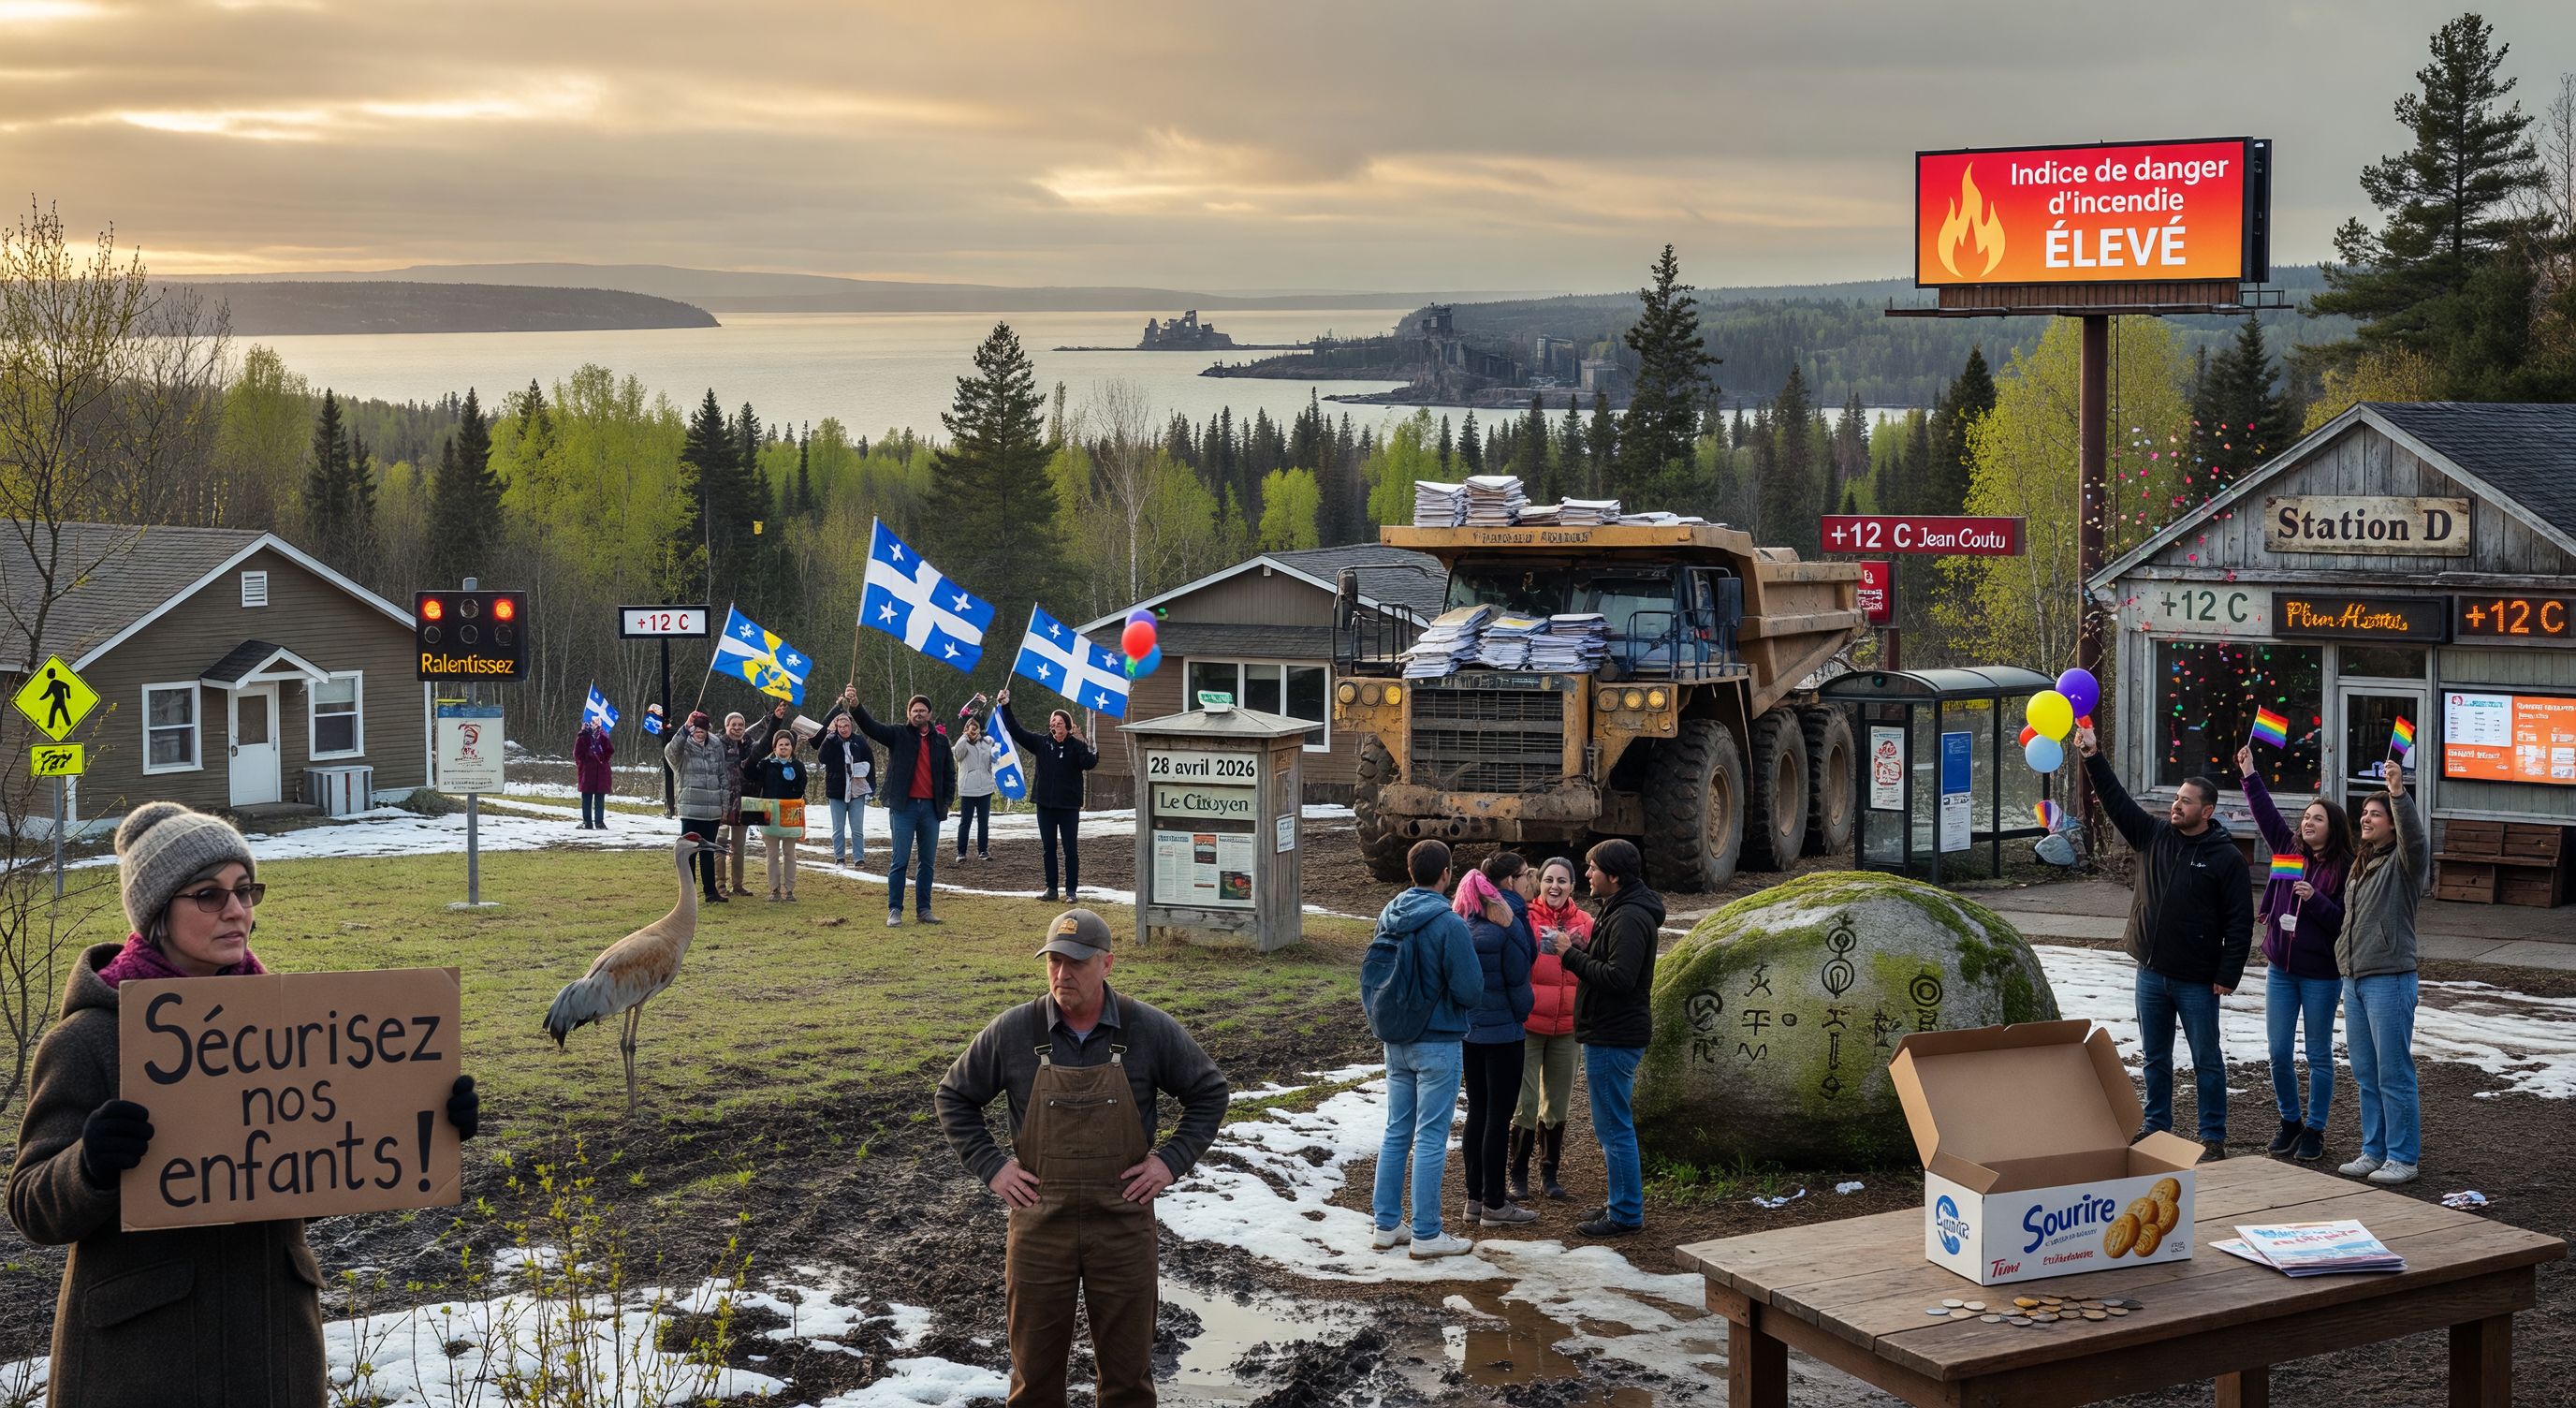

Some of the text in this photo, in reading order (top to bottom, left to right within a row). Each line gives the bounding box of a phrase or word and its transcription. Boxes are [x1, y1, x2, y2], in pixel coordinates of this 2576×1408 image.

[2012, 156, 2229, 185] Indice de danger
[2048, 187, 2184, 214] d'incendie
[2045, 215, 2187, 268] ÉLEVÉ
[1831, 522, 2005, 549] +12 C Jean Coutu
[2277, 506, 2452, 541] Station D
[637, 613, 689, 631] +12 C
[2160, 591, 2248, 623] +12 C
[2466, 600, 2565, 633] +12 C
[421, 653, 515, 674] Ralentissez
[1150, 756, 1255, 777] 28 avril 2026
[1161, 792, 1180, 809] Le
[144, 992, 443, 1085] Sécurisez
[242, 1079, 337, 1126] nos
[159, 1110, 435, 1208] enfants !
[2022, 1194, 2115, 1254] Sourire
